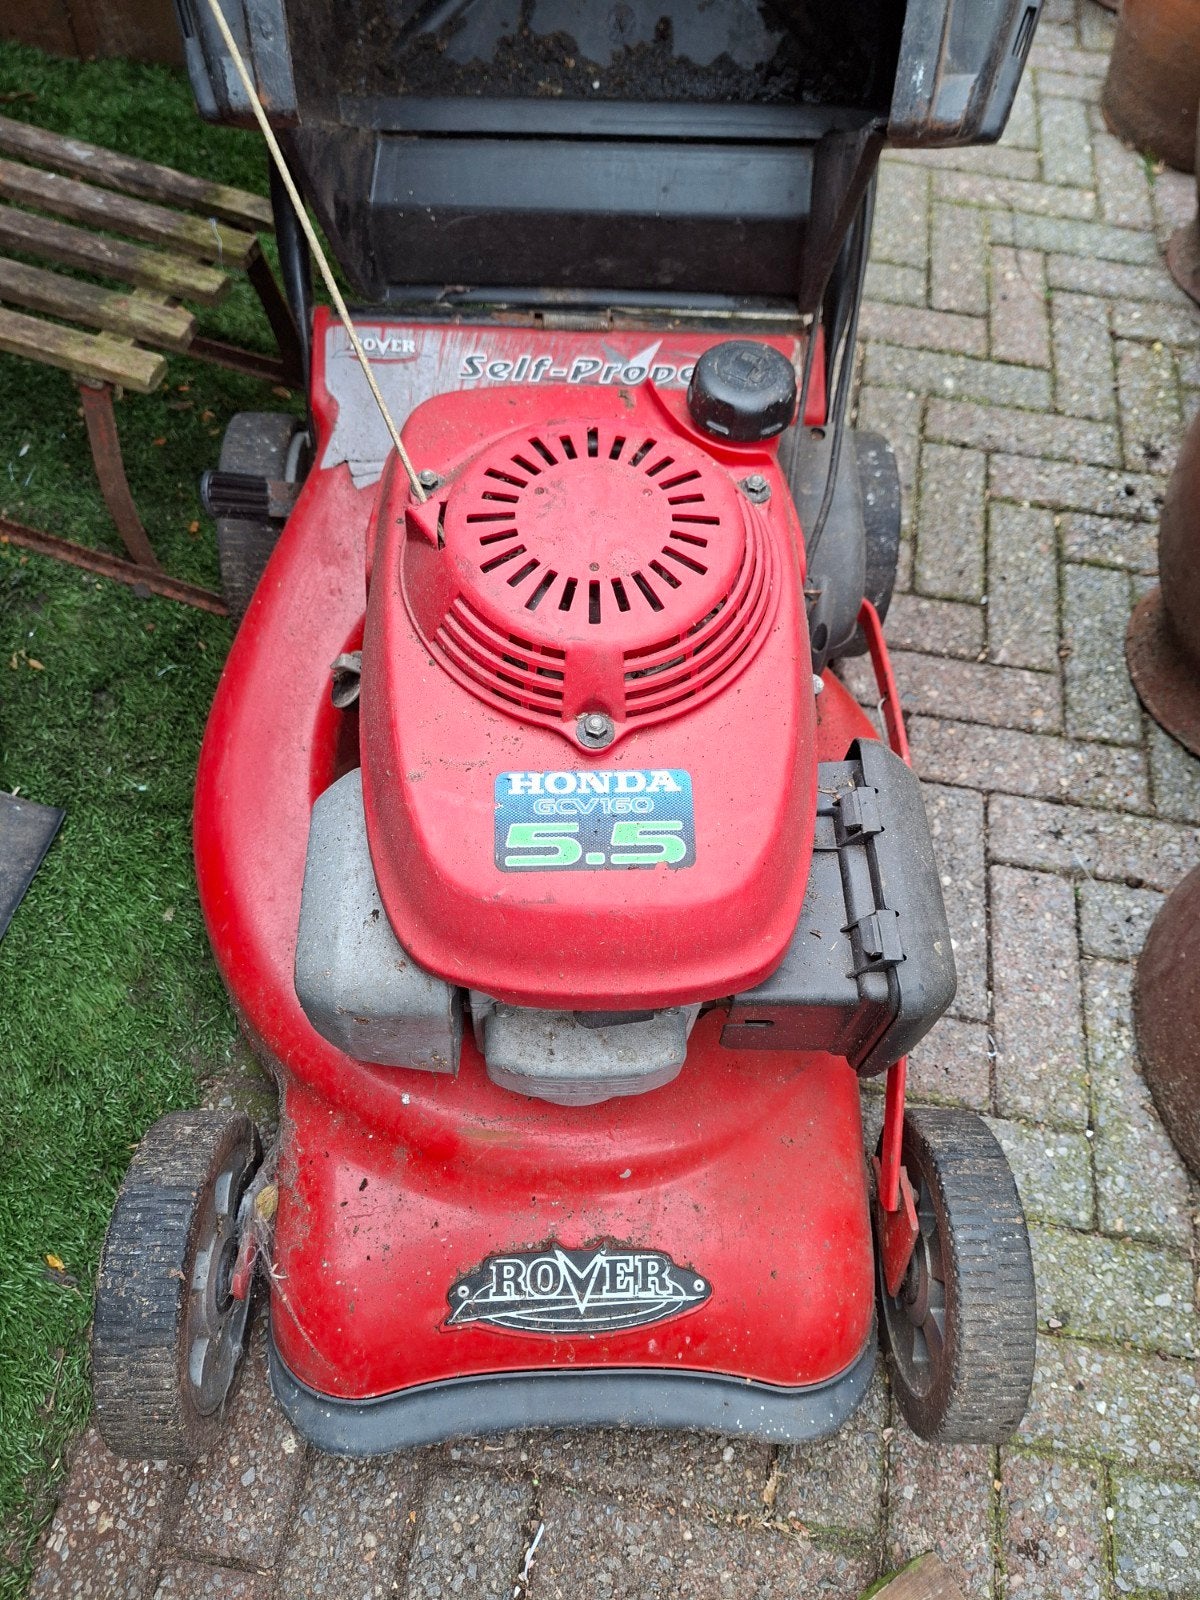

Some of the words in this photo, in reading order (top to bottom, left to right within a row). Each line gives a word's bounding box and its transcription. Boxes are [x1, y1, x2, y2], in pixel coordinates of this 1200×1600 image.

[507, 771, 682, 794] HONDA
[533, 797, 655, 815] GCV160
[504, 820, 687, 866] 5.5
[489, 1250, 673, 1314] ROVER
